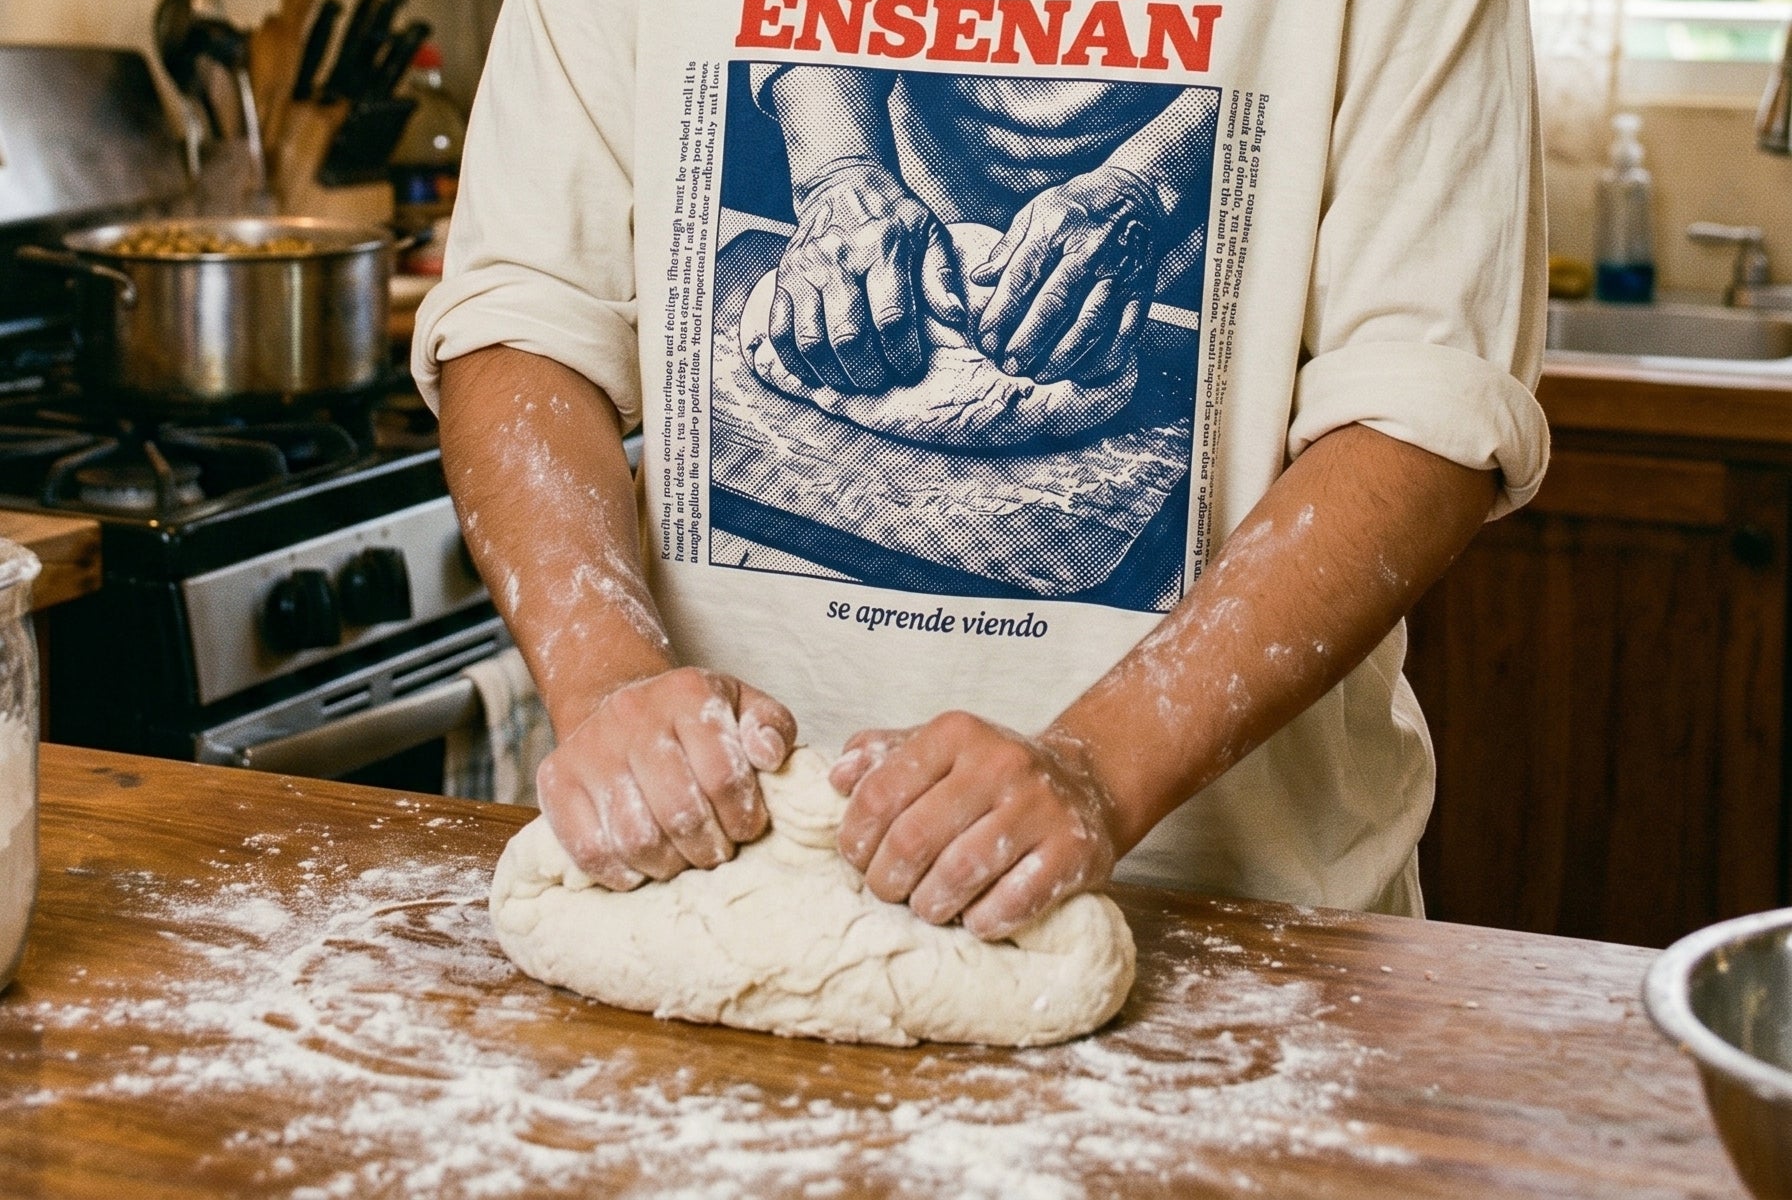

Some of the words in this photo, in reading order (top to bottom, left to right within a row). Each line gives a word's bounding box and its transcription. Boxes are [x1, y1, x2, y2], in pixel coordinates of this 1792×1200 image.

[827, 601, 850, 620] se
[856, 607, 955, 633] aprende
[962, 611, 1047, 638] viendo
